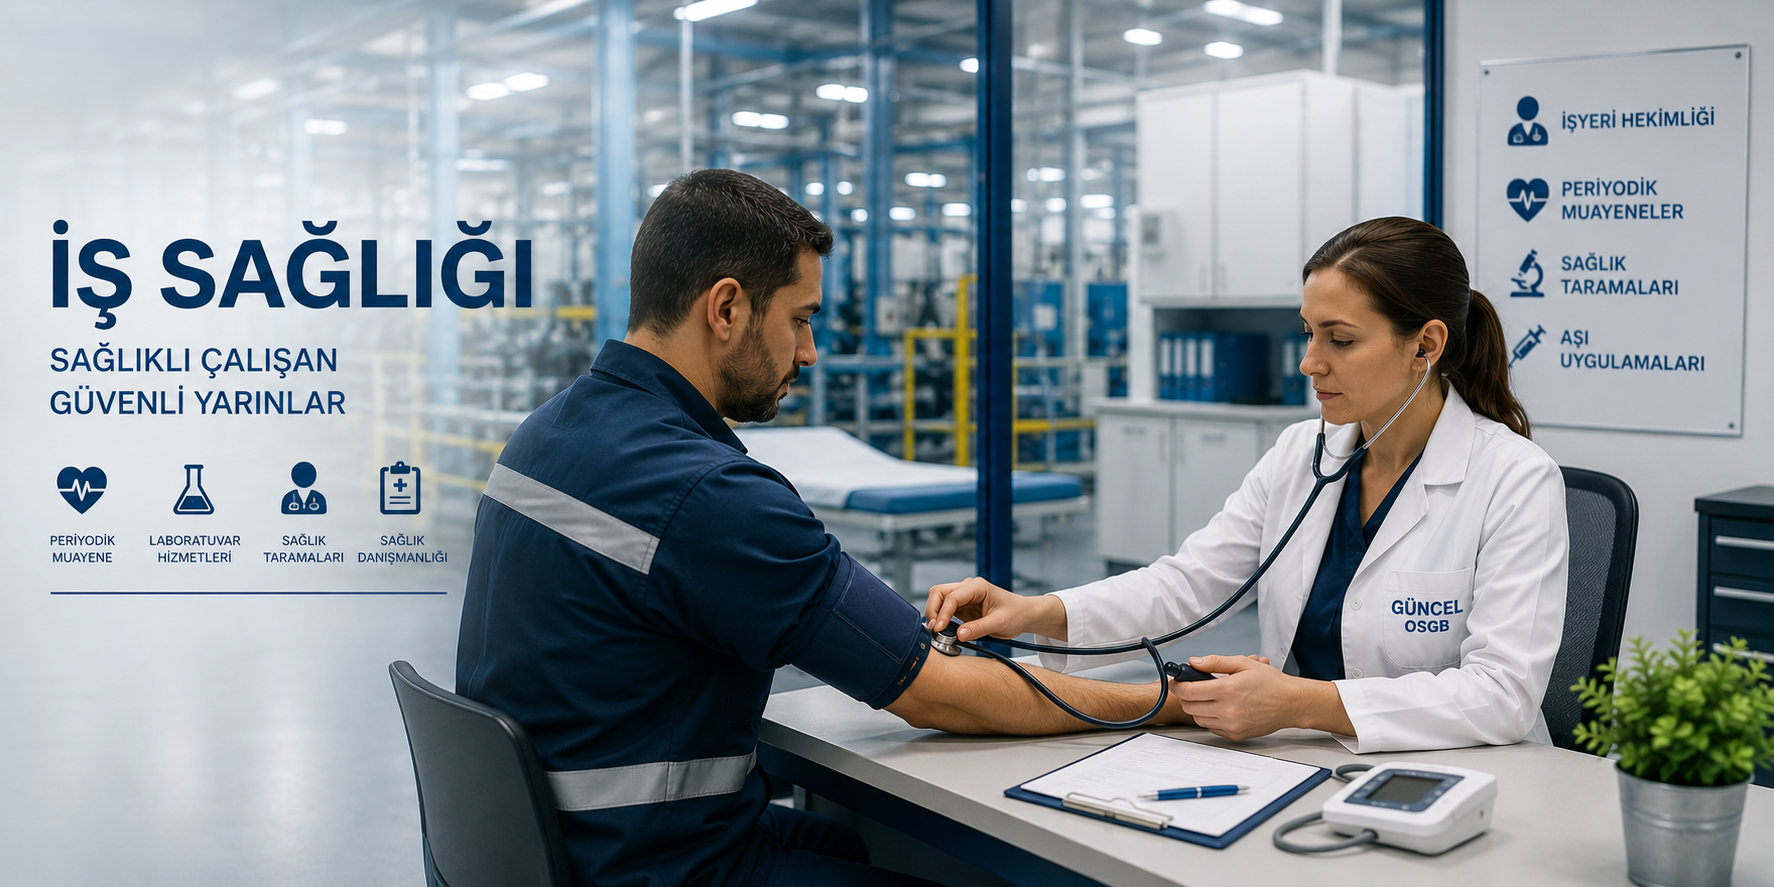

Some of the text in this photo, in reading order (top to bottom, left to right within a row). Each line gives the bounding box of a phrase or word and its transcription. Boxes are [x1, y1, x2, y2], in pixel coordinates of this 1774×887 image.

[1562, 106, 1715, 133] İŞYERİ HEKİMLİĞİ
[1562, 176, 1658, 197] PERİYODİK
[1562, 203, 1684, 220] MUAYENELER
[1561, 252, 1627, 272] SAĞLIK
[1560, 279, 1679, 296] TARAMALARI
[1560, 329, 1589, 349] AŞI
[1560, 352, 1705, 372] UYGULAMALARI
[1391, 597, 1464, 617] GÜNCEL
[1404, 619, 1450, 633] OSGB
